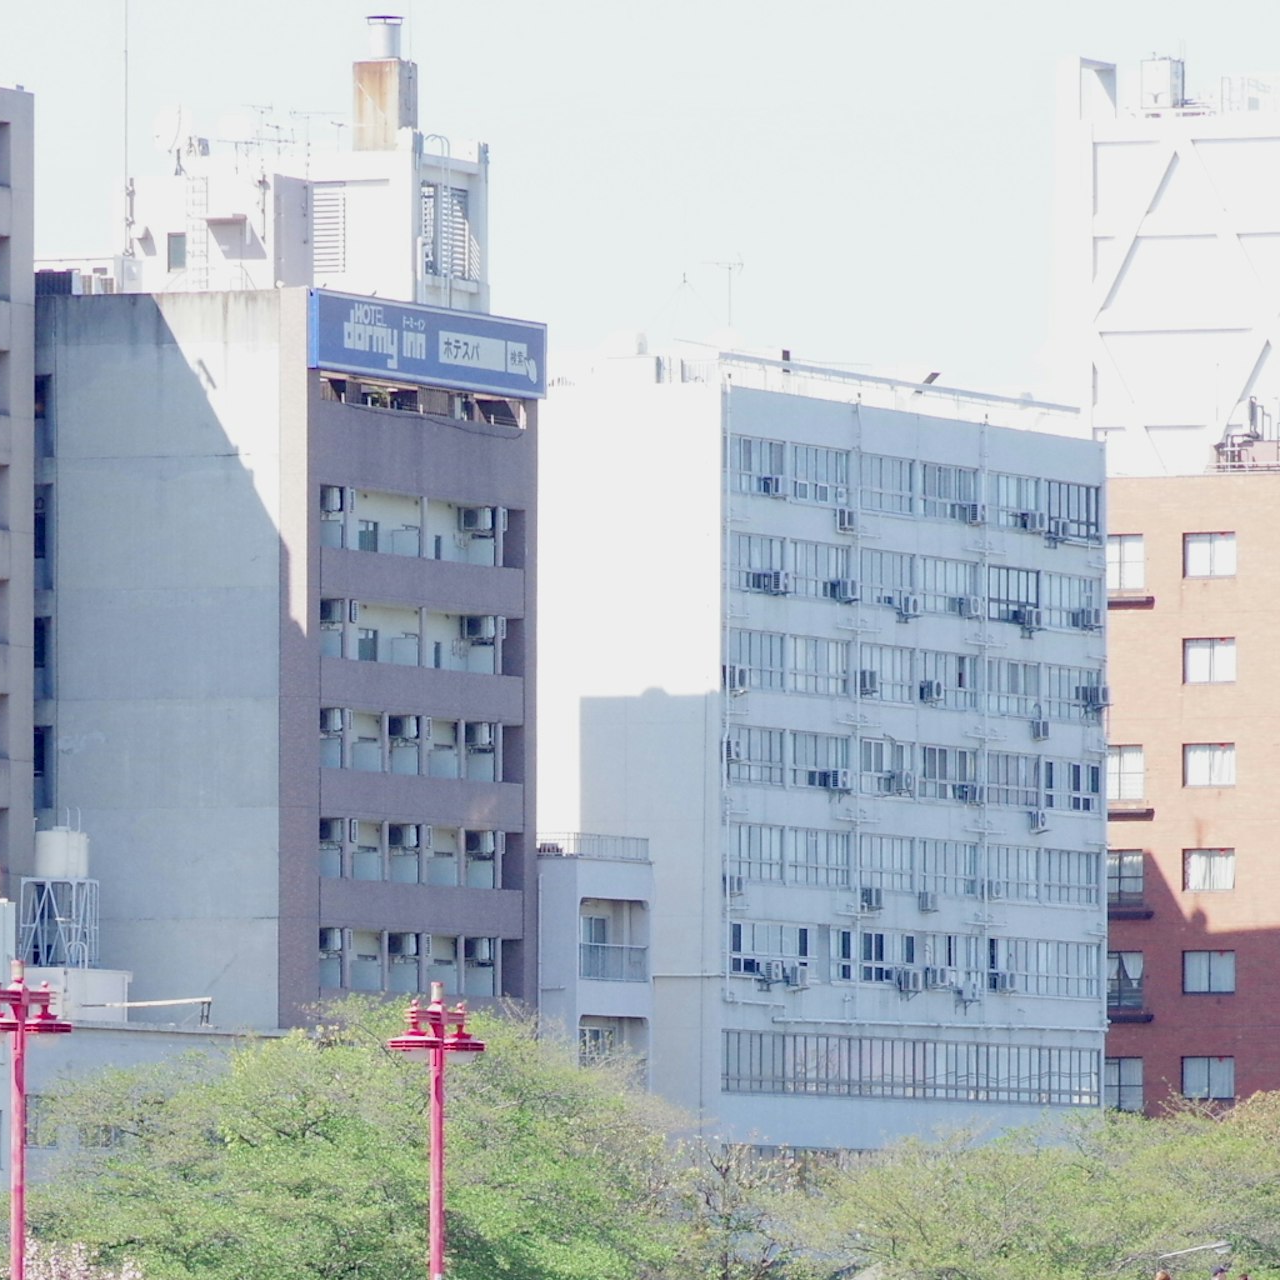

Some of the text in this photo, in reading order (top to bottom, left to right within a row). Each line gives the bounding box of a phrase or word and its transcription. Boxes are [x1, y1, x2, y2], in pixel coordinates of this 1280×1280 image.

[354, 302, 387, 327] HOTEL
[343, 308, 426, 370] dormy inn
